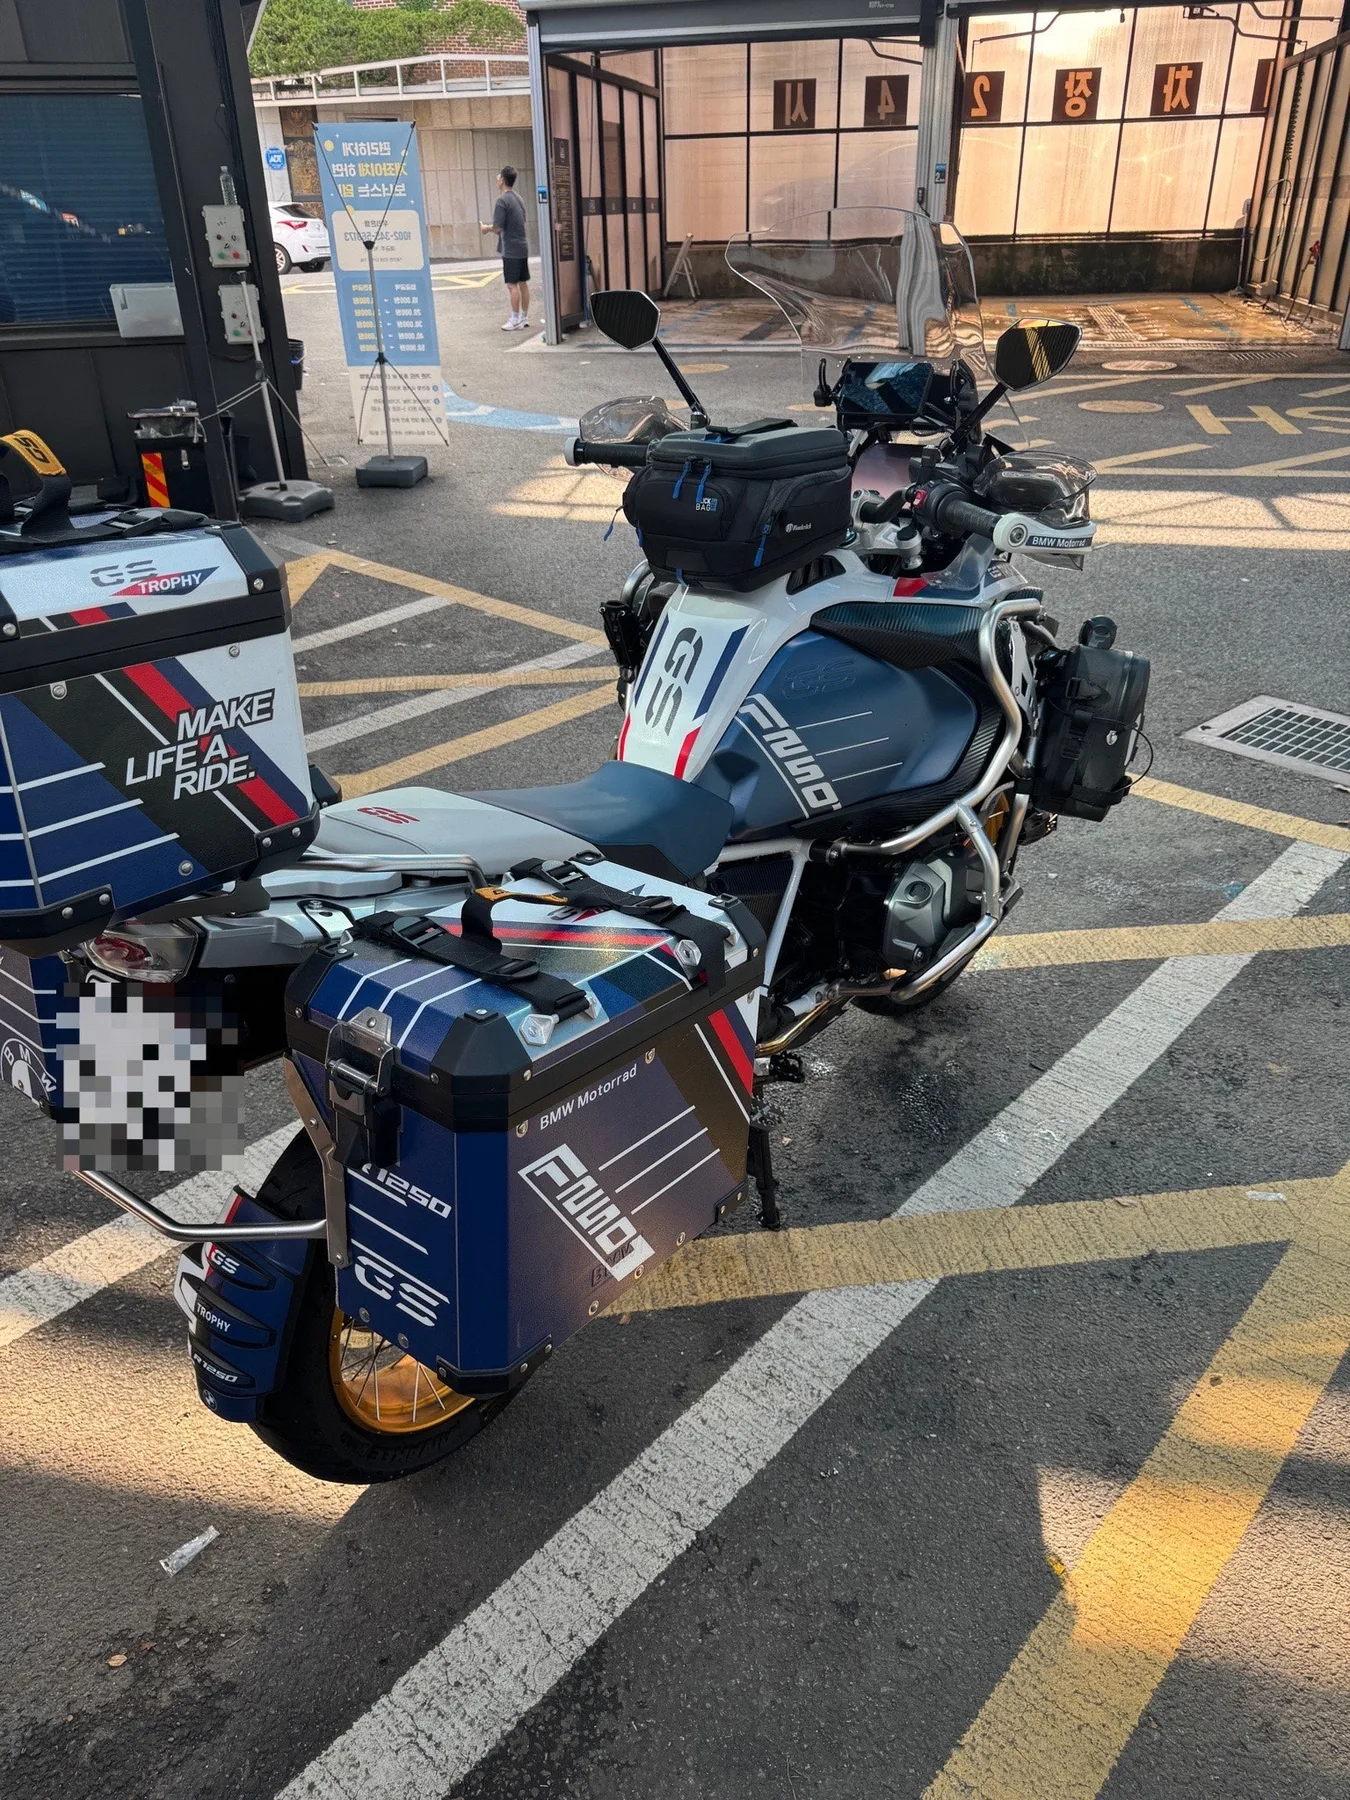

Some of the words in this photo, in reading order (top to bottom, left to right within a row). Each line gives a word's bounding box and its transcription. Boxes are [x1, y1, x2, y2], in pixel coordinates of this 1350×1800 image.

[695, 503, 711, 511] BAG
[1032, 537, 1057, 547] BMW
[1057, 538, 1086, 548] Motorrad
[90, 560, 157, 588] GS
[138, 572, 203, 595] TROPHY
[644, 627, 704, 736] GS
[176, 688, 275, 741] MAKE
[126, 741, 198, 786] LIFE
[203, 734, 228, 764] A
[173, 756, 256, 800] RIDE.
[539, 1103, 576, 1131] BMW
[577, 1064, 639, 1116] Motorrad
[210, 1248, 241, 1275] GS
[354, 1255, 440, 1327] GS
[196, 1303, 231, 1333] TROPHY
[192, 1352, 238, 1384] R1250
